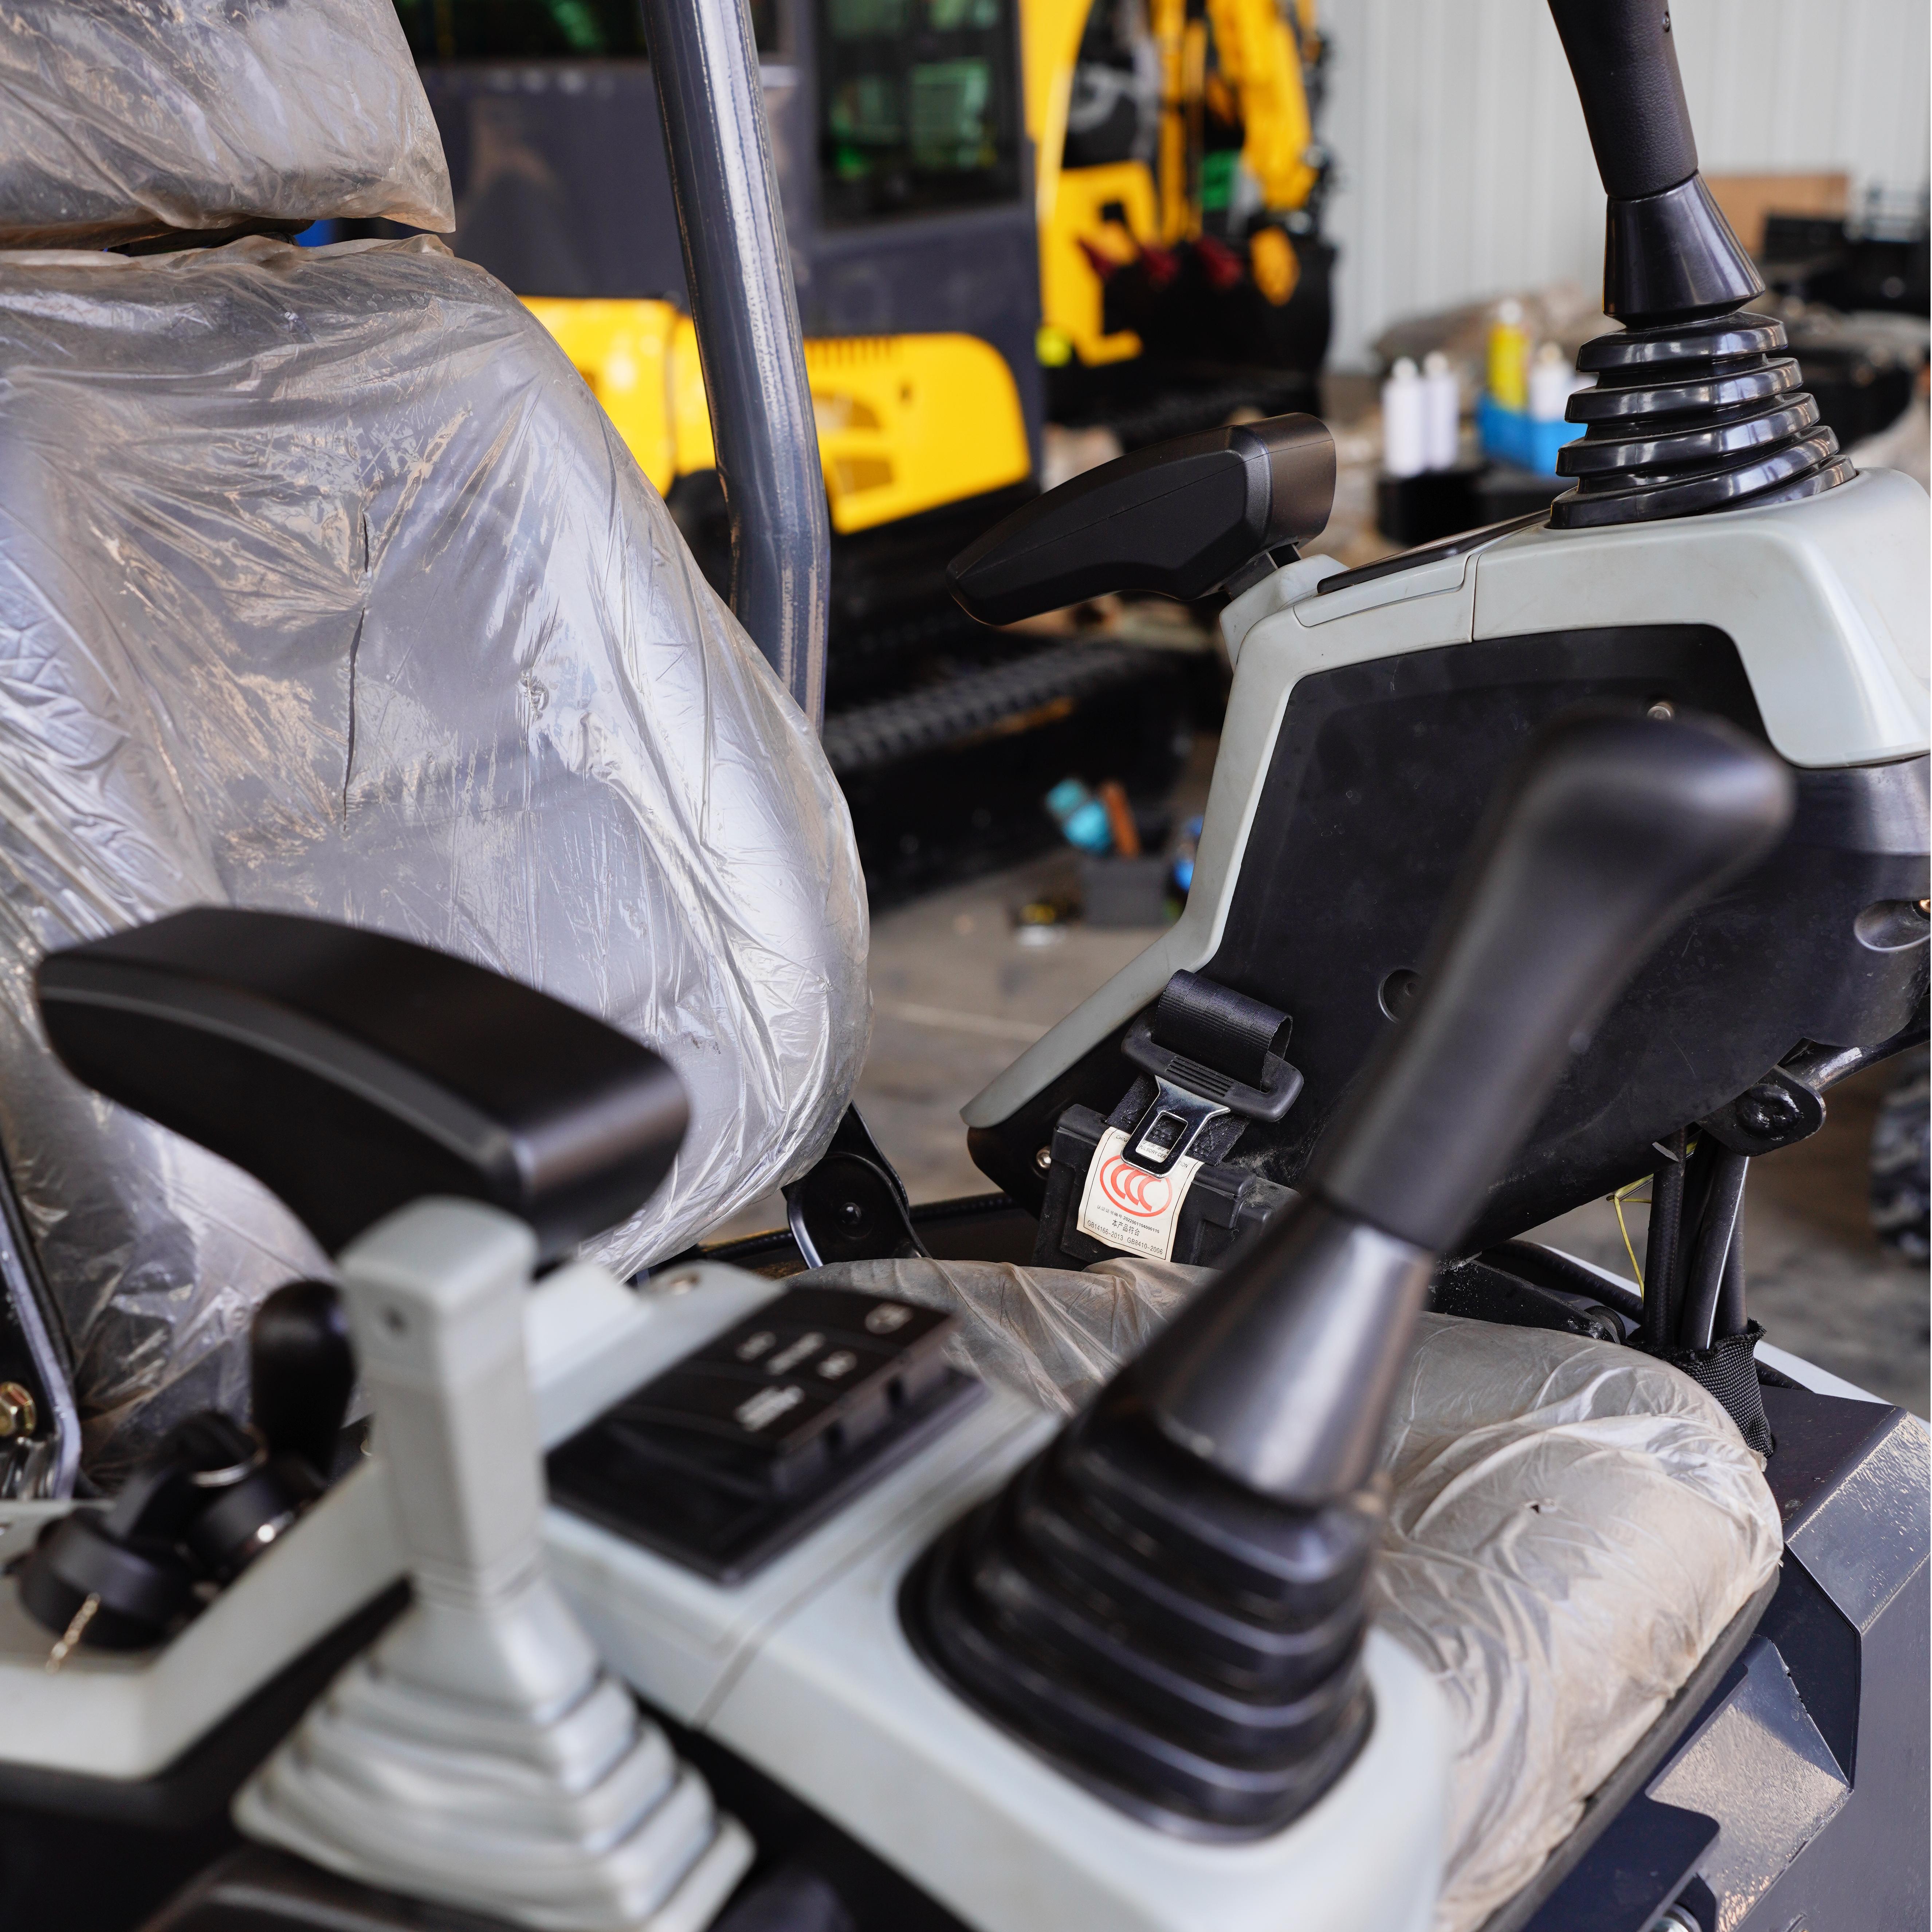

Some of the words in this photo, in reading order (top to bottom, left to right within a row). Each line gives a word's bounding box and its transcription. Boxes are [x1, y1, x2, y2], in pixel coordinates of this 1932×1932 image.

[1087, 1220, 1123, 1241] GB14166-2013
[1127, 1237, 1163, 1254] GB8410-2006
[1112, 1219, 1140, 1236] 本产品符合
